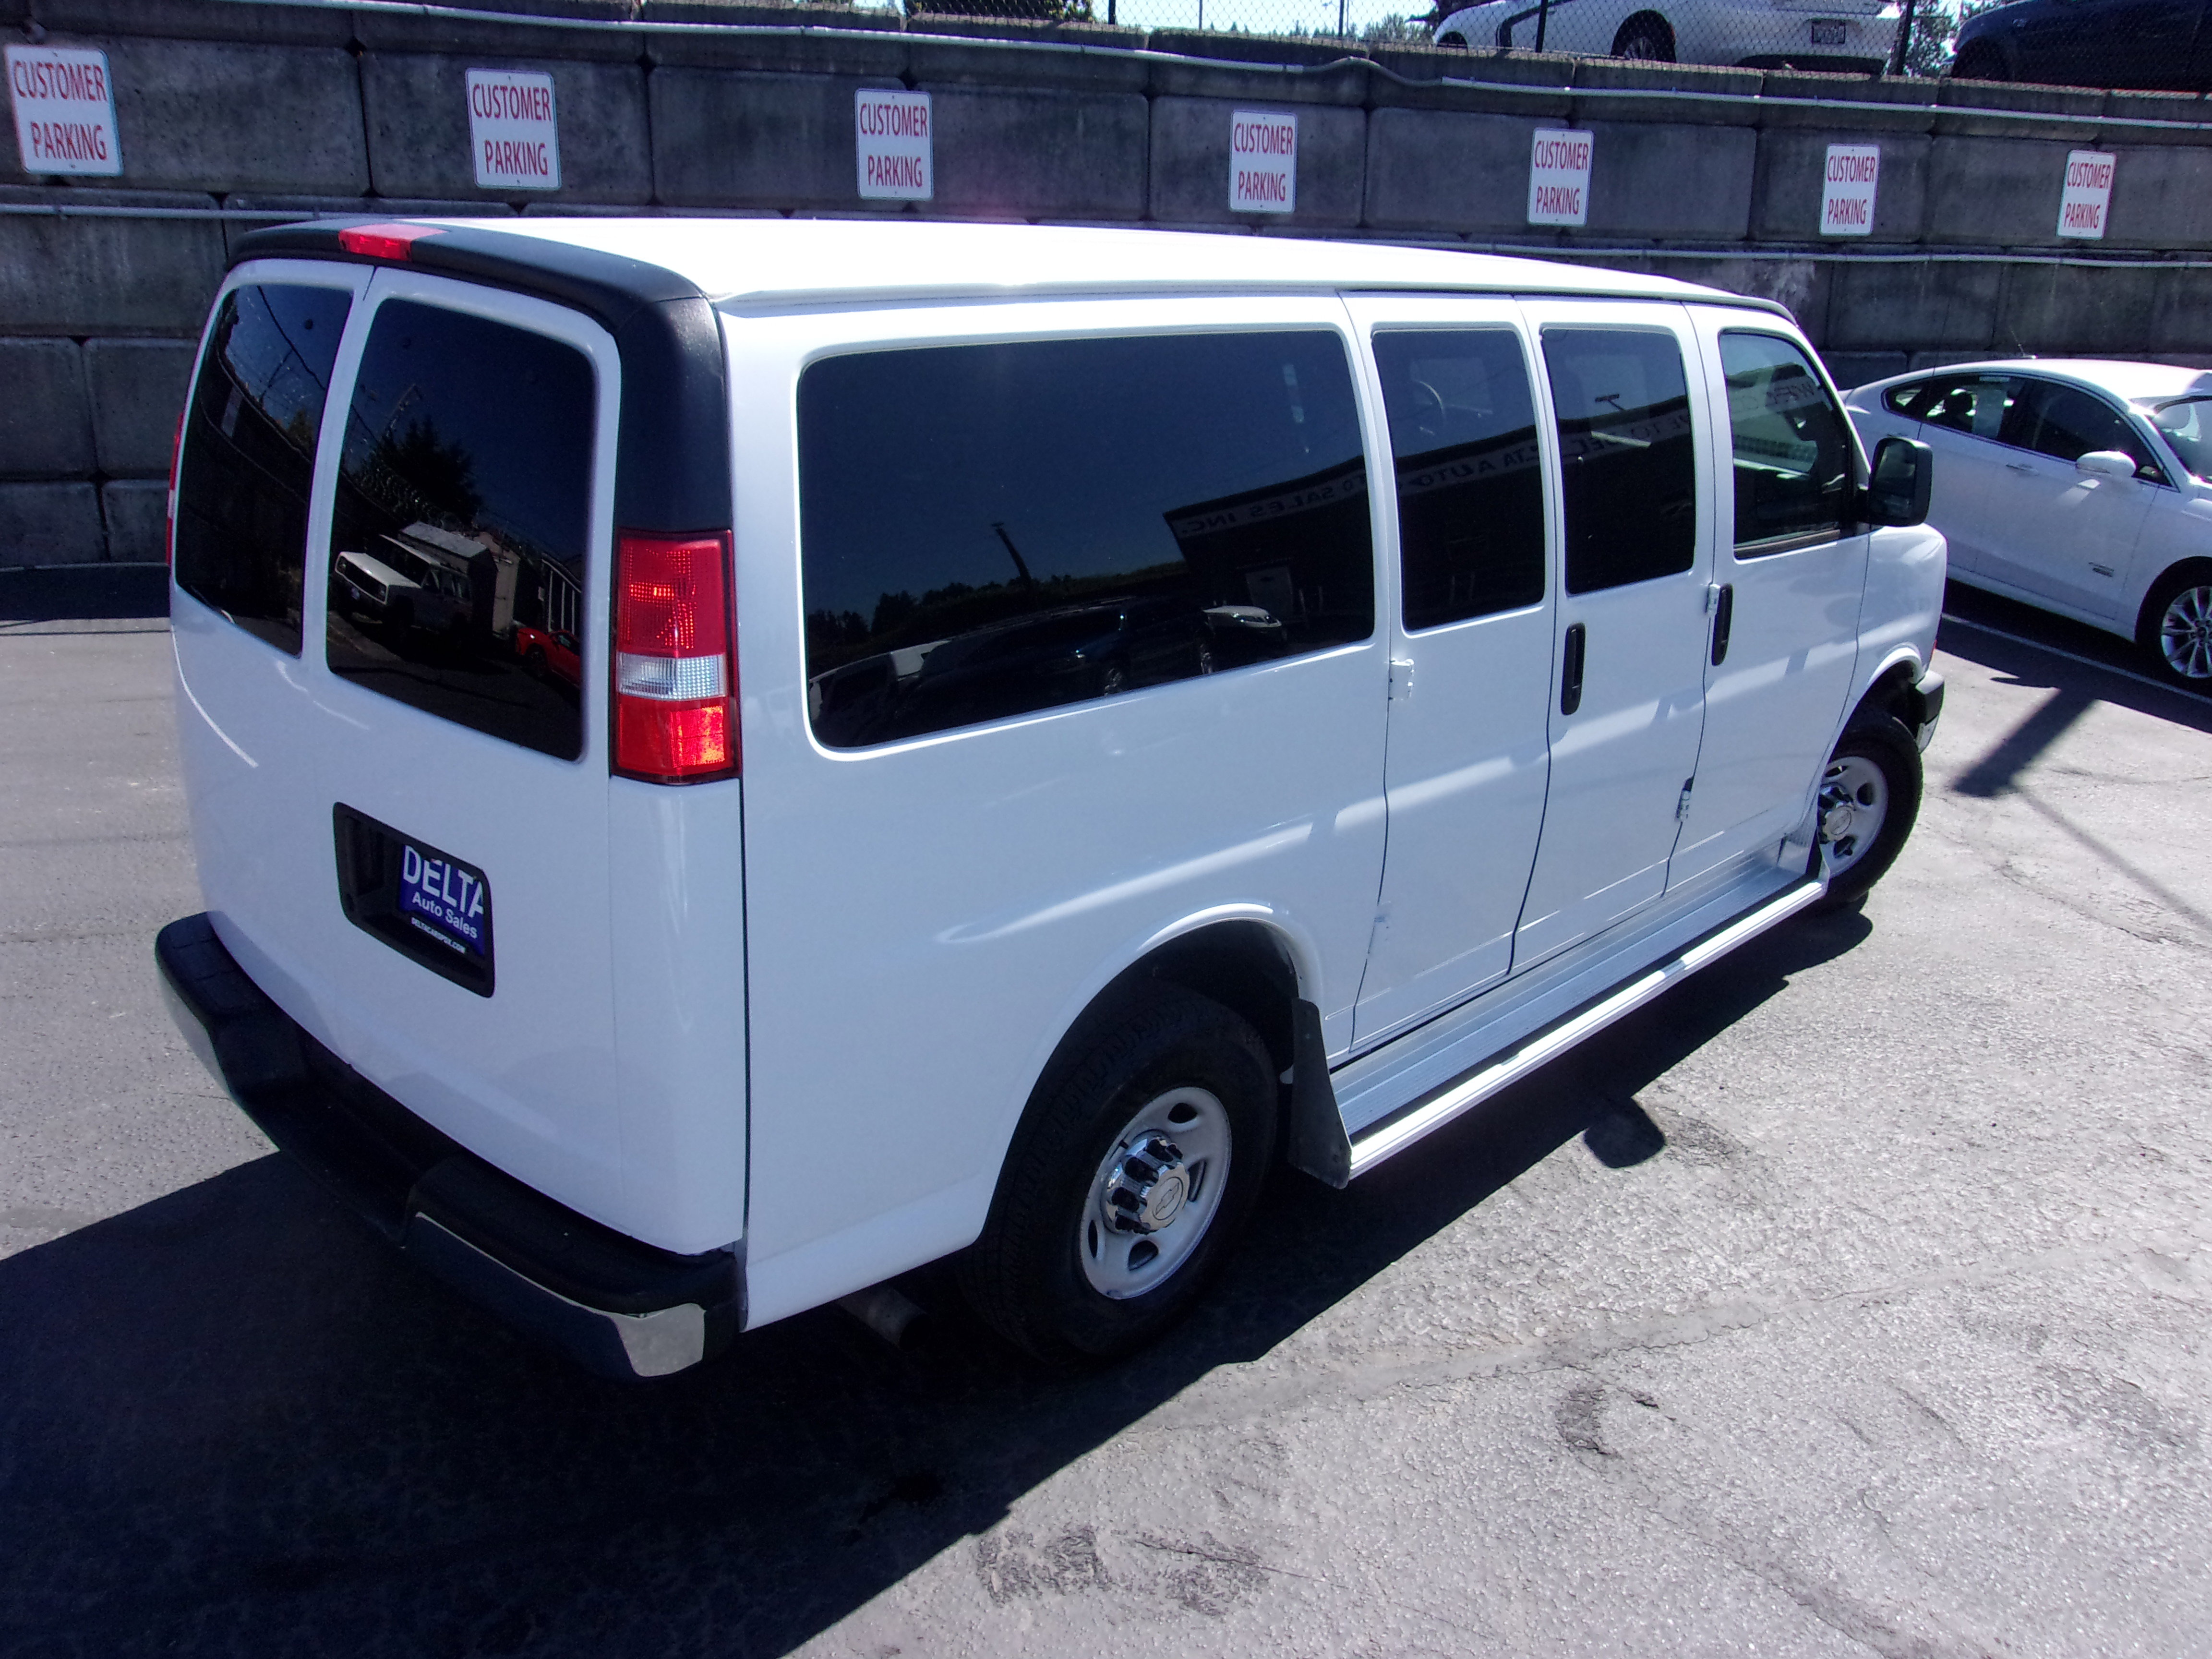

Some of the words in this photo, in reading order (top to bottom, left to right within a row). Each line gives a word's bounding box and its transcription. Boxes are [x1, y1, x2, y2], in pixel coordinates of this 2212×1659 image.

[14, 60, 107, 101] CUSTOMER
[473, 84, 552, 120] CUSTOMER
[860, 103, 927, 137] CUSTOMER
[31, 121, 107, 161] PARKING
[1234, 123, 1293, 155] CUSTOMER
[484, 140, 548, 176] PARKING
[868, 155, 923, 188] PARKING
[1535, 141, 1589, 170] CUSTOMER
[1827, 156, 1874, 183] CUSTOMER
[1238, 171, 1286, 202] PARKING
[2067, 162, 2111, 188] CUSTOMER
[1537, 186, 1580, 215] PARKING
[1827, 199, 1867, 225] PARKING
[2064, 203, 2101, 229] PARKING
[403, 845, 484, 918] DELTA
[412, 891, 443, 917] Auto
[445, 909, 478, 938] Sales
